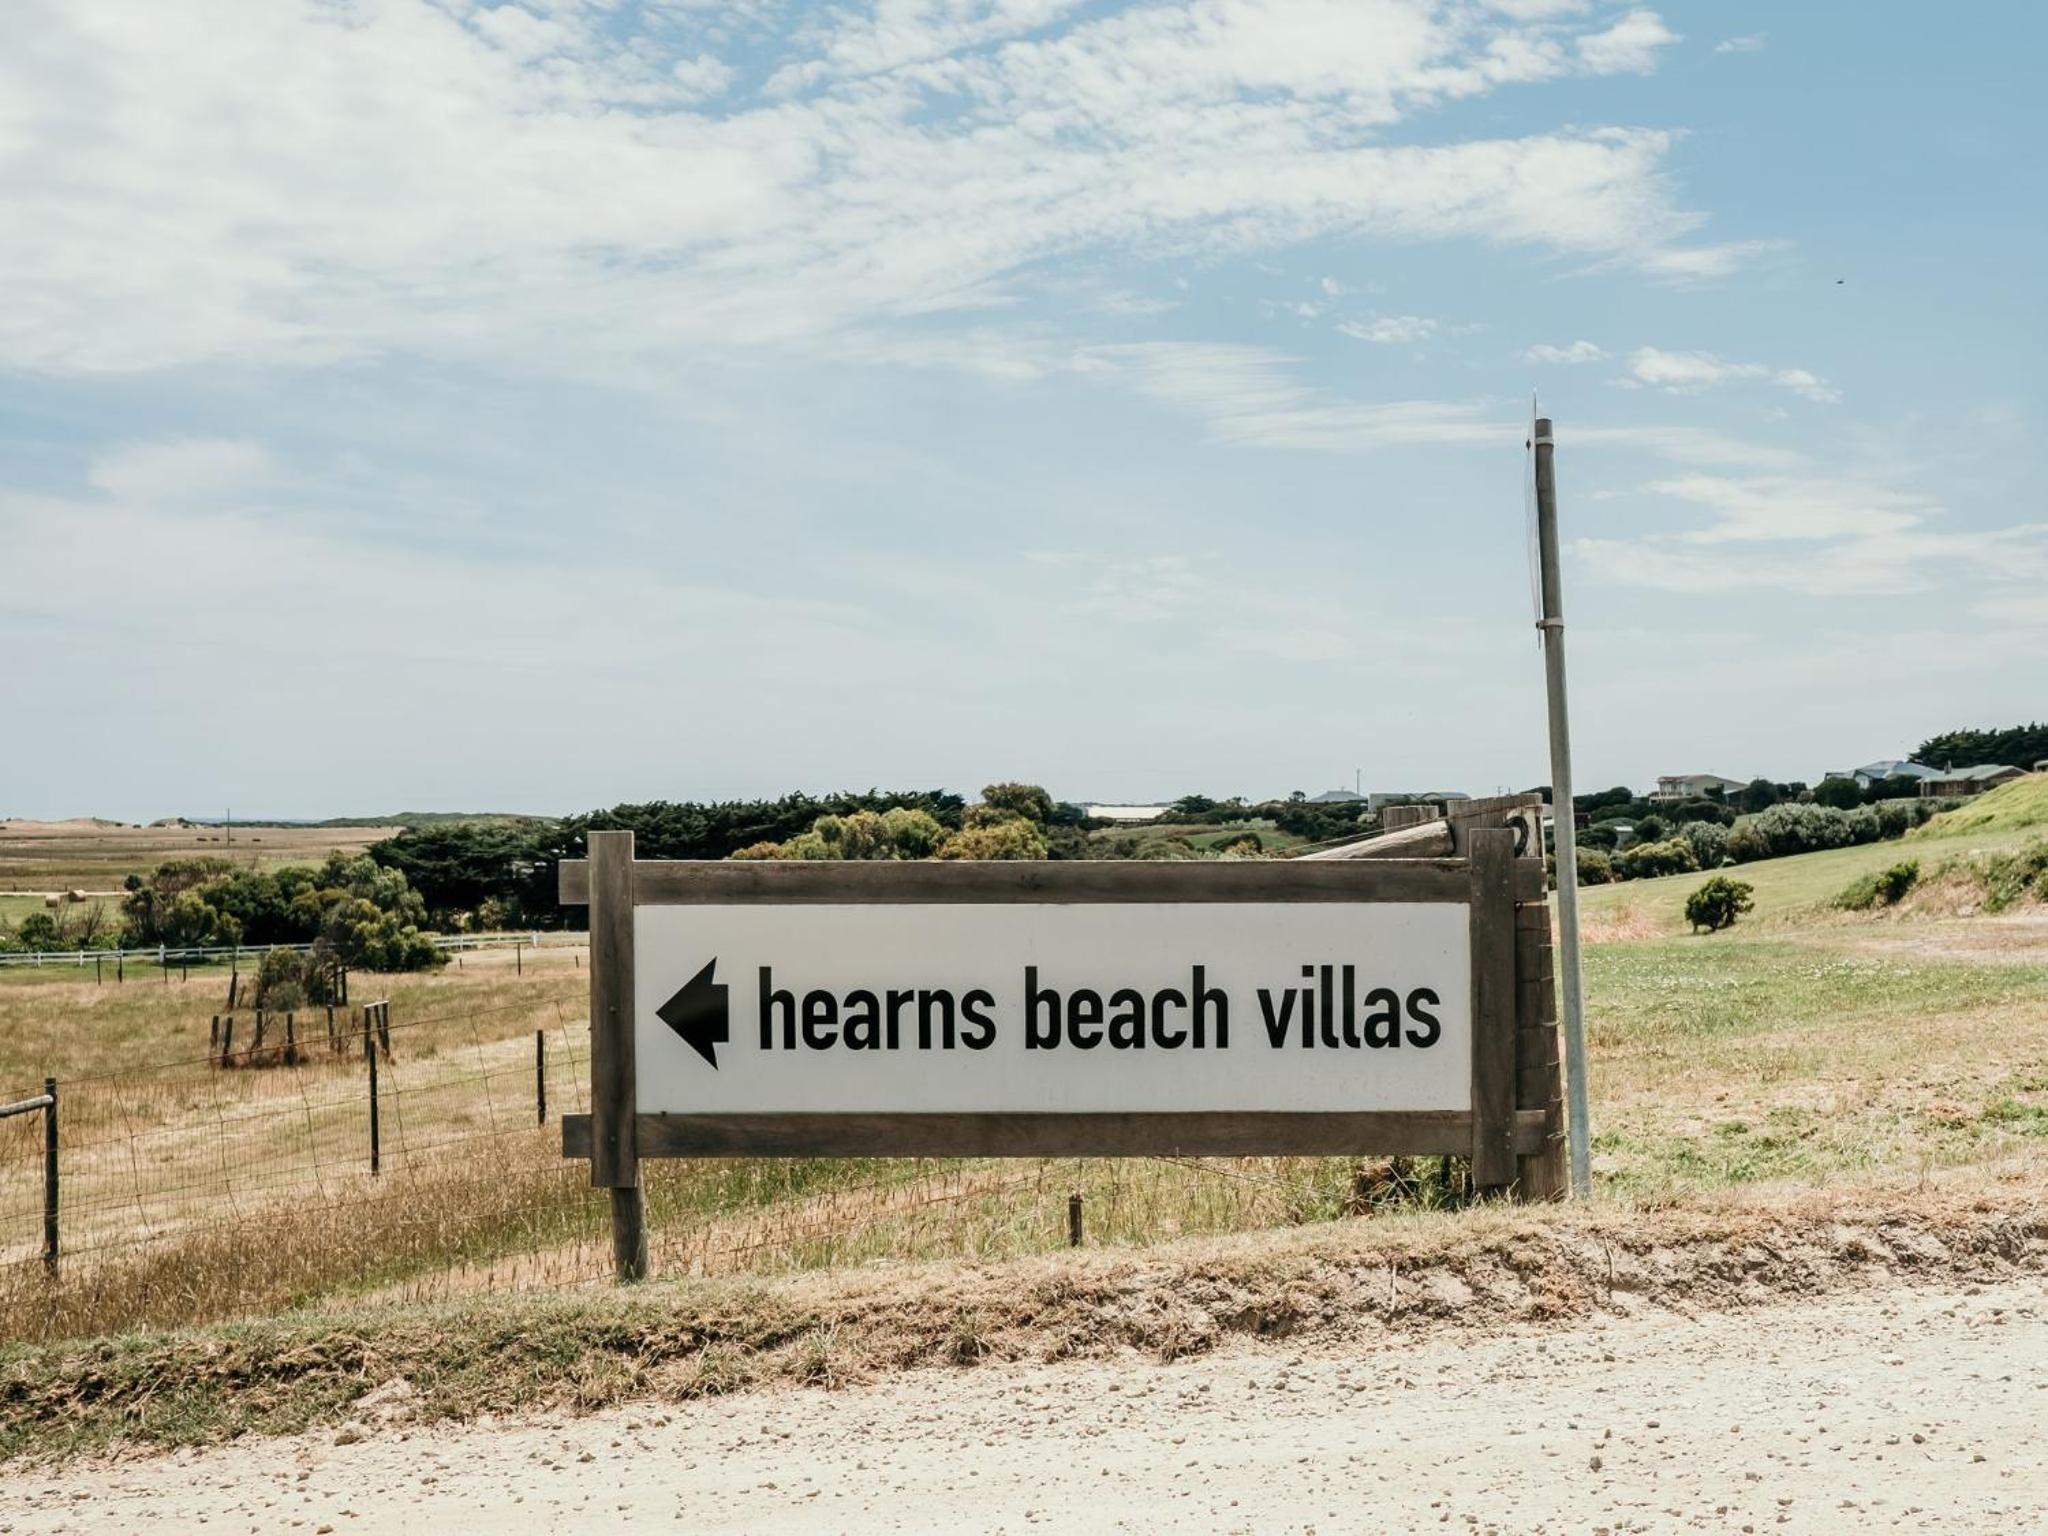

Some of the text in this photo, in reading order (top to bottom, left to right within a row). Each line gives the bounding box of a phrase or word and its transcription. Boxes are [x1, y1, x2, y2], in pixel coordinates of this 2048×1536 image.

[759, 964, 1442, 1051] hearns beach villas
